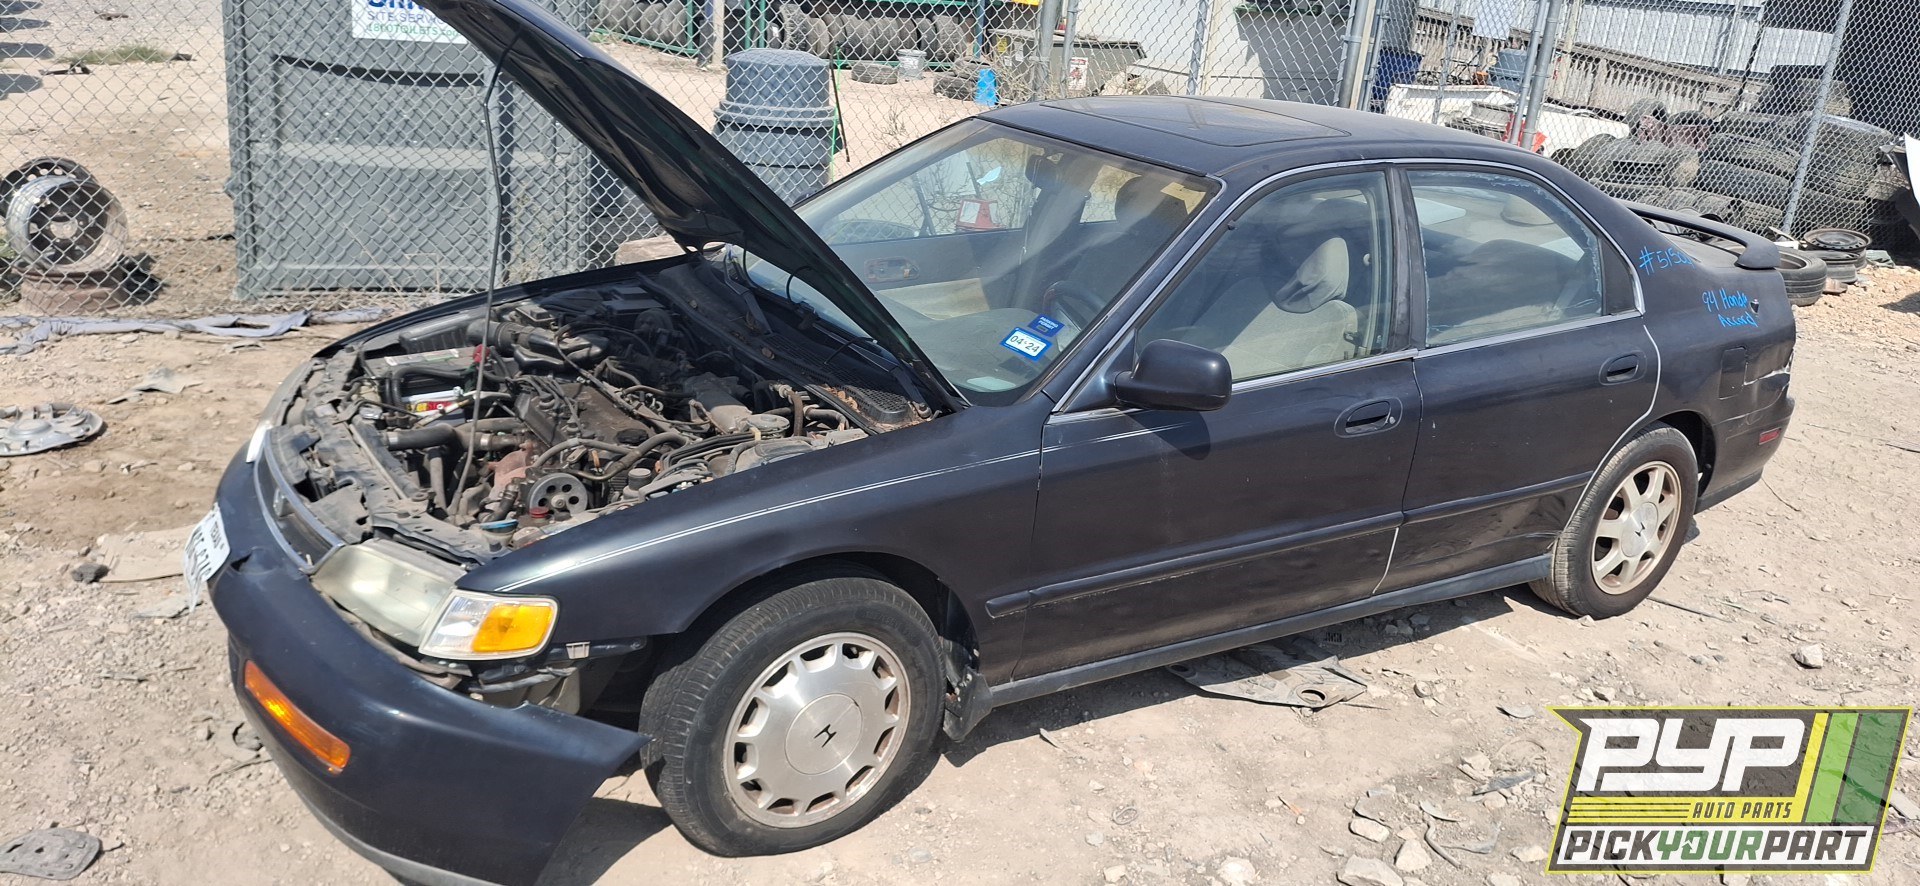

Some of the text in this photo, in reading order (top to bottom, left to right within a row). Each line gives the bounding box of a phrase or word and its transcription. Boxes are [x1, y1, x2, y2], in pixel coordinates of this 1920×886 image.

[1702, 288, 1748, 312] 94 Honda
[1718, 311, 1759, 328] Accord
